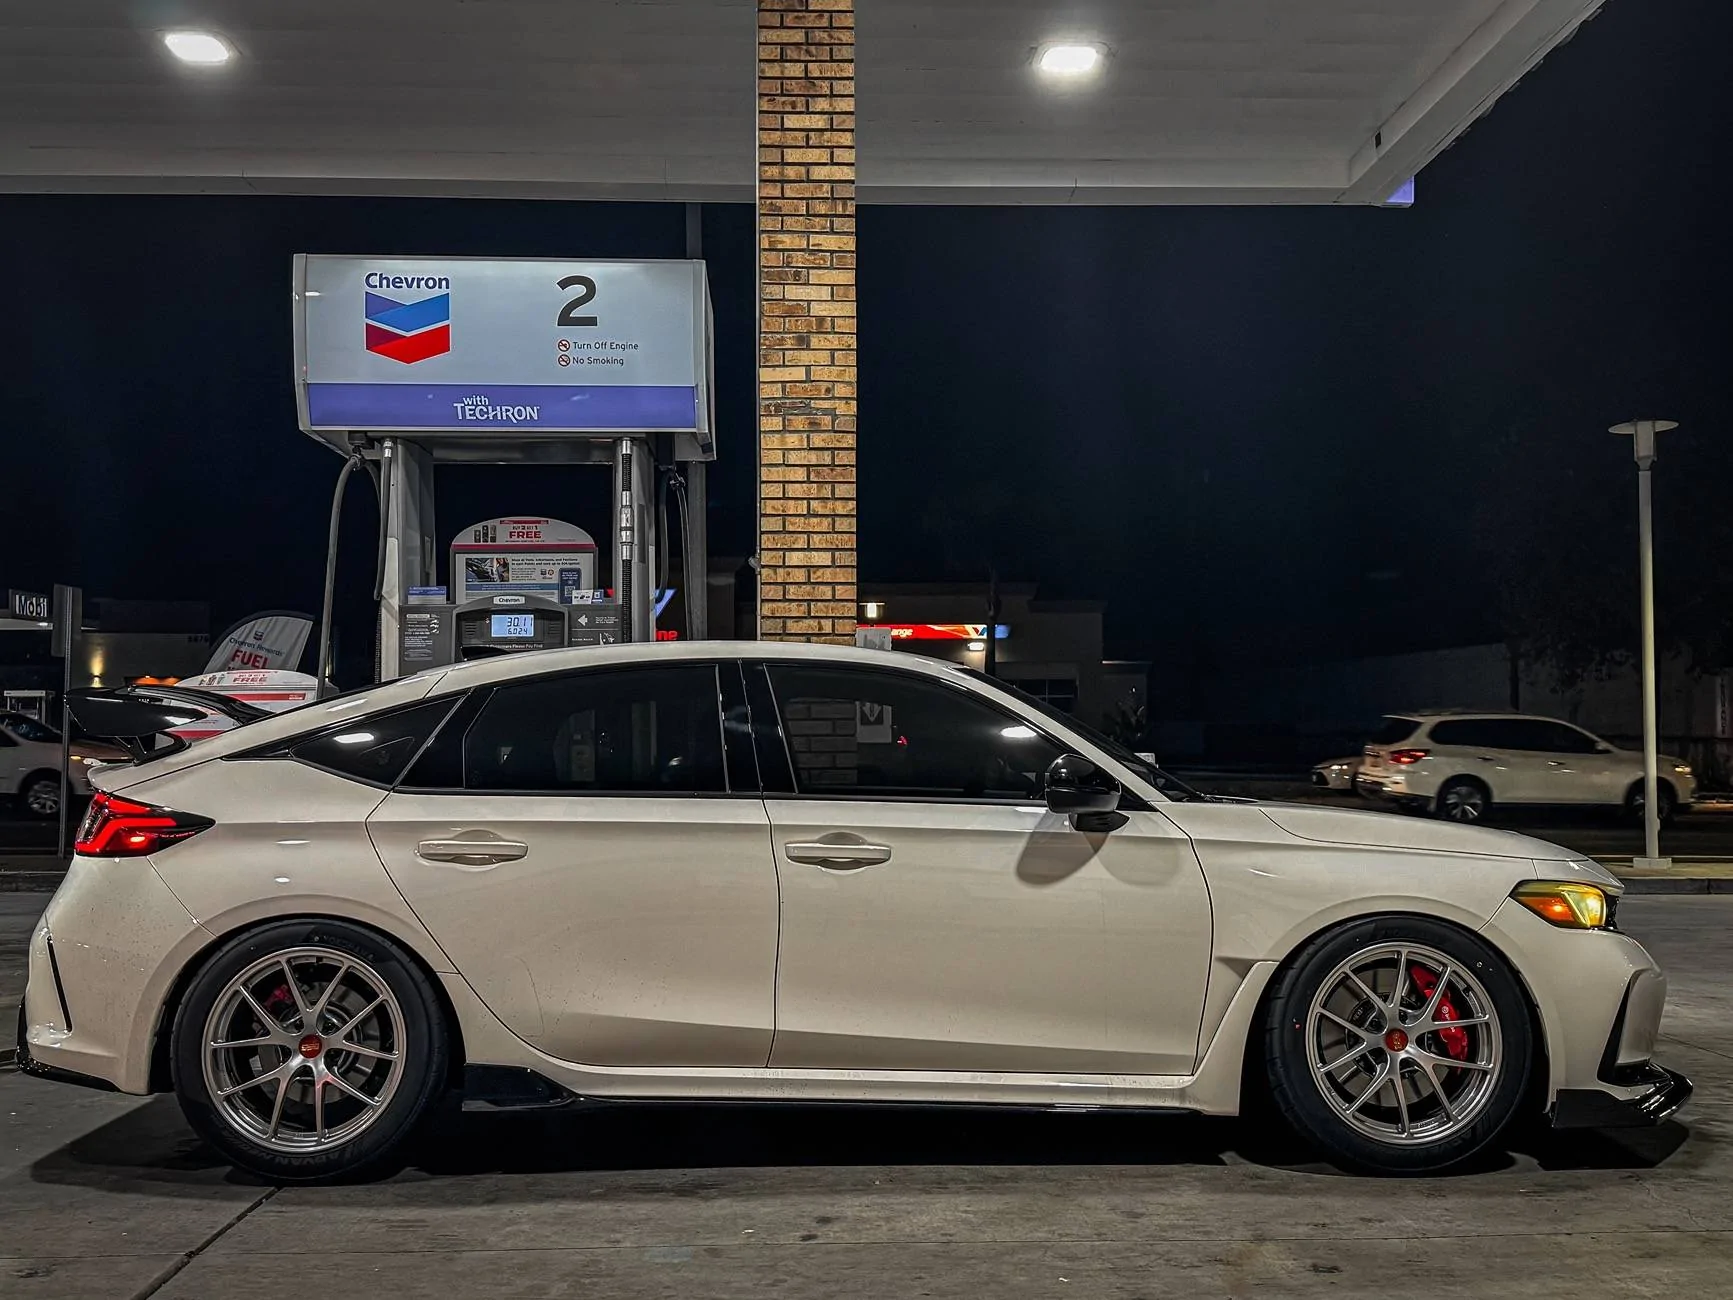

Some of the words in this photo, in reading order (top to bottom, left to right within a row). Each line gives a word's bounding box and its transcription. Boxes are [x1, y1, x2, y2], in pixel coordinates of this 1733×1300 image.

[365, 272, 450, 290] Chevron
[557, 275, 598, 326] 2
[573, 341, 592, 350] Turn
[594, 341, 607, 350] Off
[610, 341, 639, 352] Engine
[572, 357, 585, 365] No
[587, 356, 624, 366] Smoking
[463, 395, 489, 405] with
[453, 403, 539, 423] TECHRON
[509, 531, 542, 539] FREE
[890, 628, 914, 638] ange
